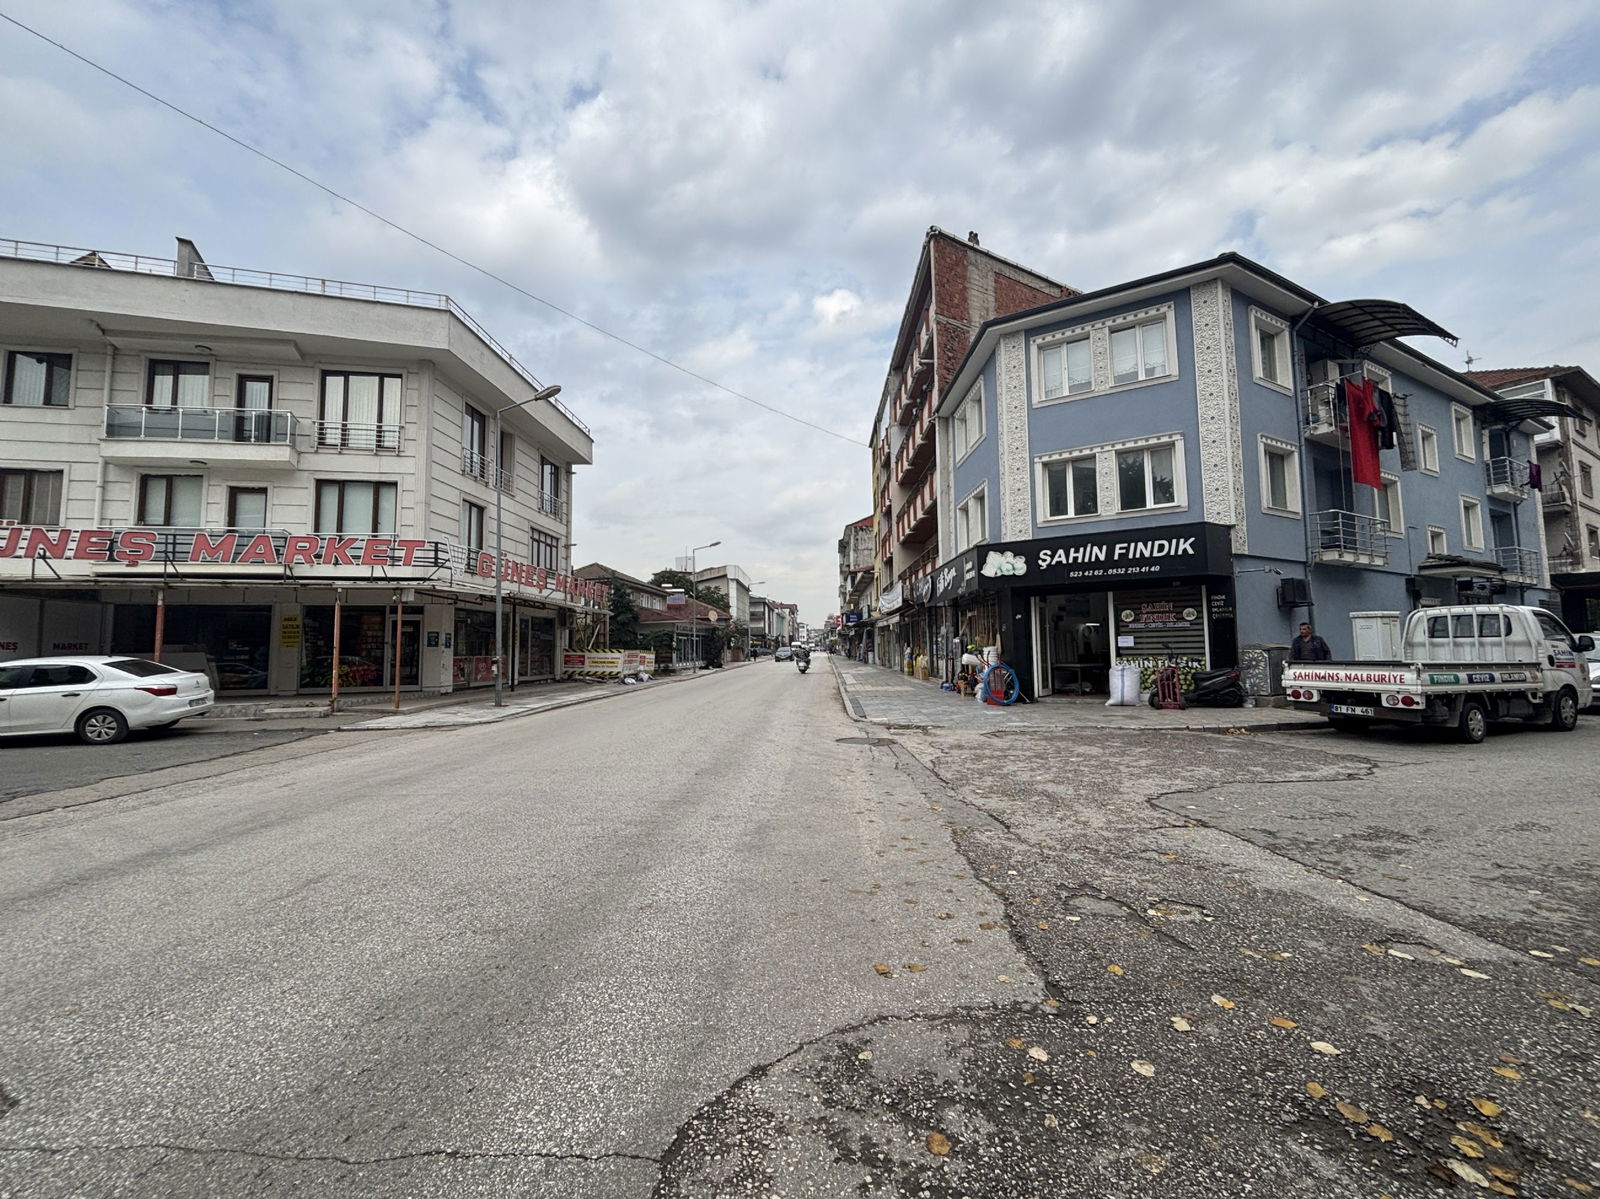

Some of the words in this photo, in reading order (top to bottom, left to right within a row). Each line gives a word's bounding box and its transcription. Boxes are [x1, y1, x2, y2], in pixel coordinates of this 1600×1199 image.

[188, 532, 428, 567] MARKET
[1037, 543, 1107, 570] ŞAHİN
[1113, 537, 1196, 560] FINDIK
[477, 551, 548, 594] GÜNEŞ
[555, 572, 610, 604] MARKET
[53, 642, 89, 651] MARKET
[1344, 672, 1406, 684] NALBURİYE
